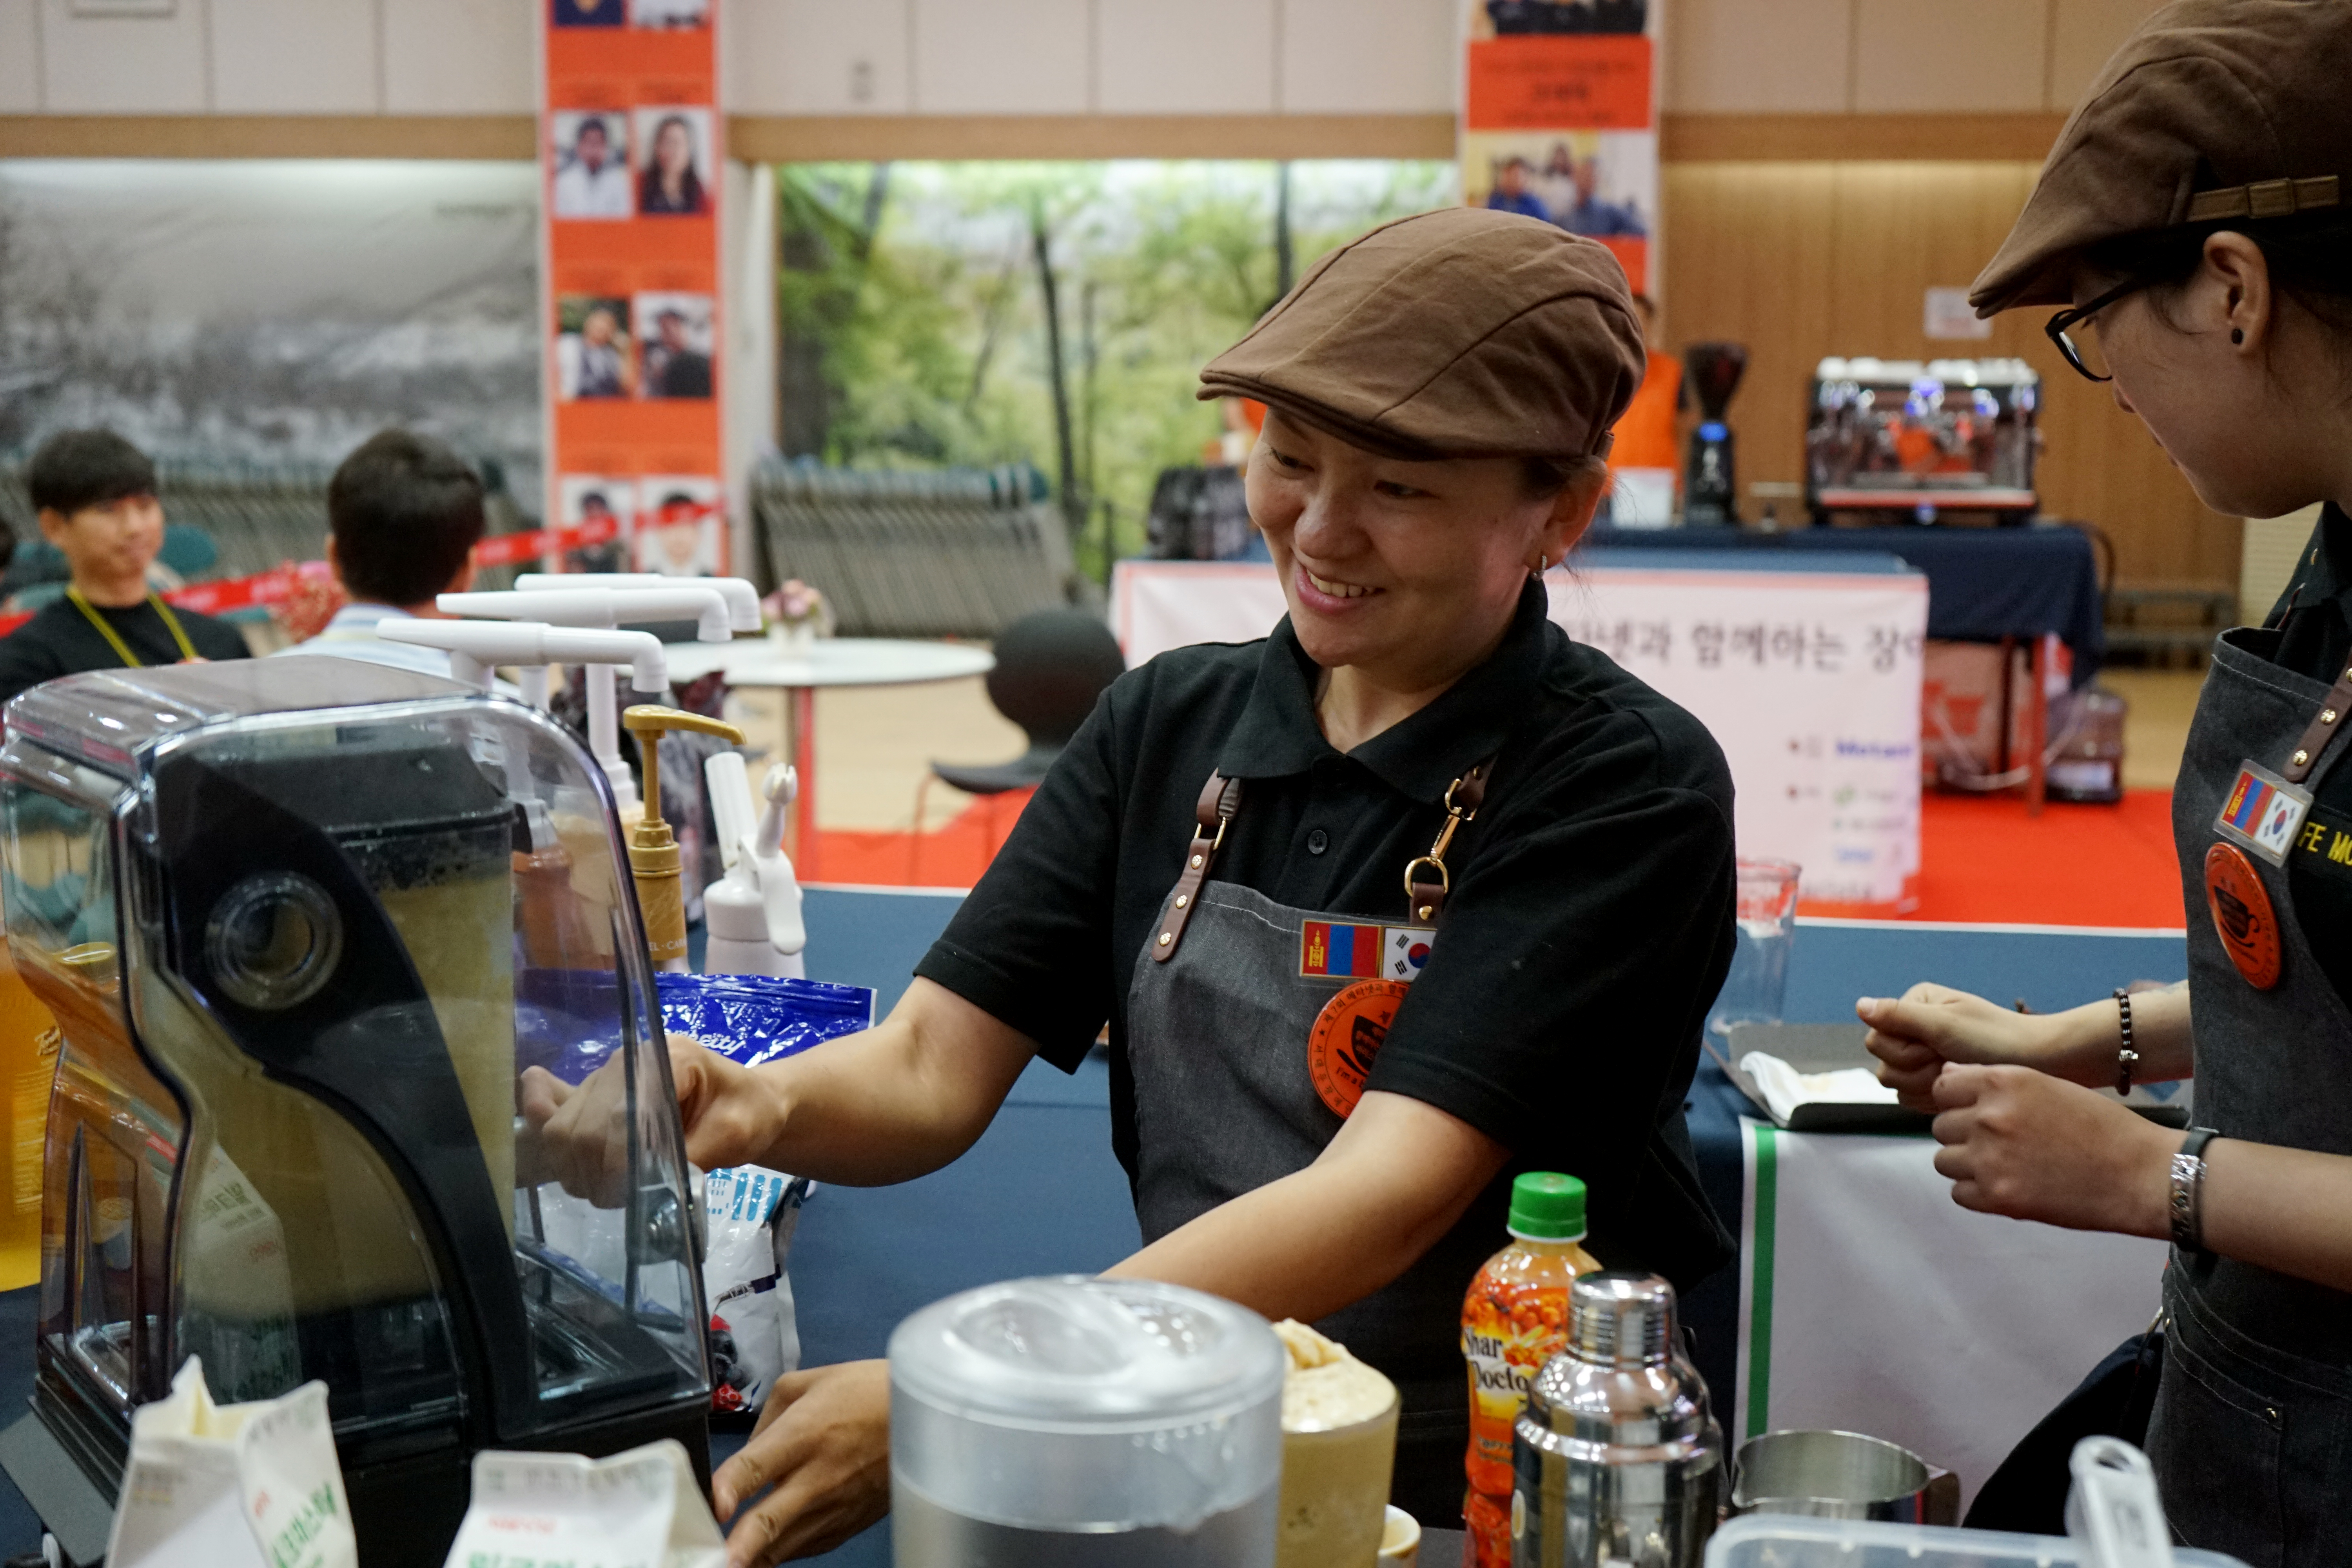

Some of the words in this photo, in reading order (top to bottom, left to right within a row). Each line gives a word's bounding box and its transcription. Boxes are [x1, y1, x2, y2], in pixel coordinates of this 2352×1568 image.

[1691, 623, 1846, 673] 함께하는
[2298, 821, 2327, 852] FE
[1472, 1360, 1530, 1391] Docto
